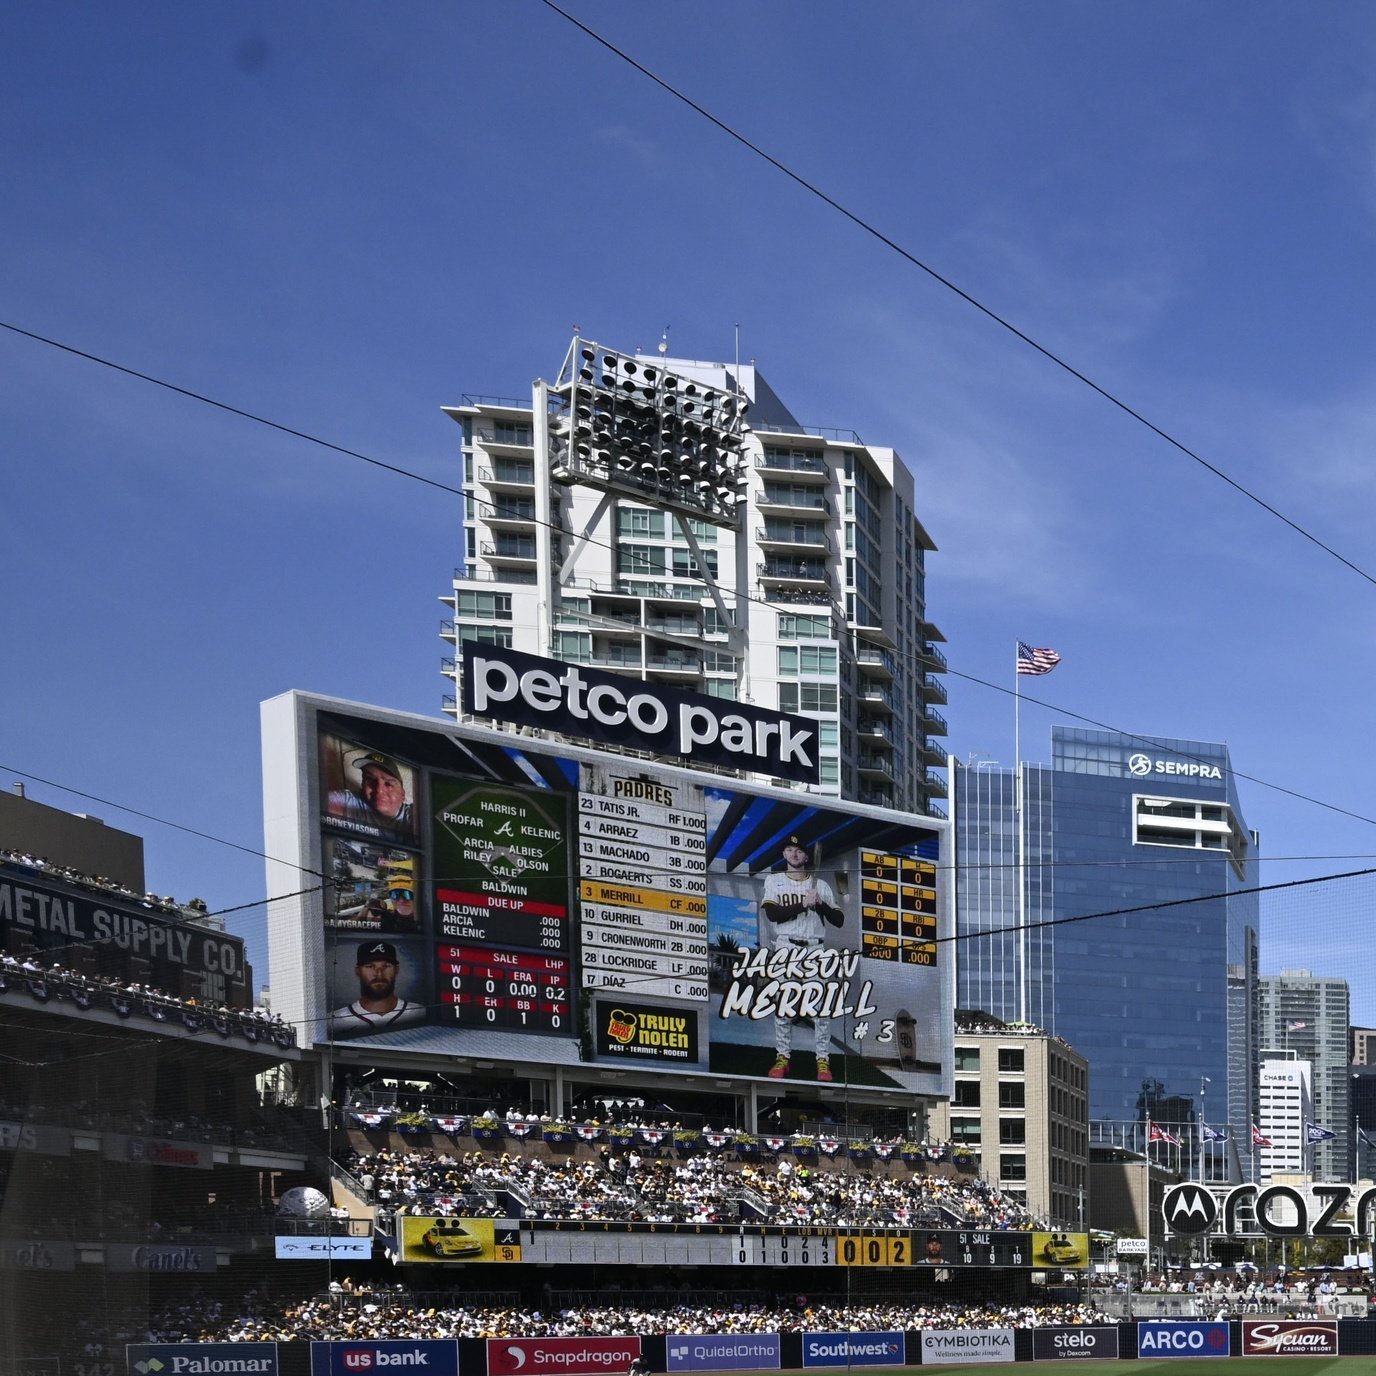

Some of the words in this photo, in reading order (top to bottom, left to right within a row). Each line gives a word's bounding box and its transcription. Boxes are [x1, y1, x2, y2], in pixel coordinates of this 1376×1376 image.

[473, 656, 668, 734] petco
[680, 703, 814, 767] park
[1155, 760, 1222, 779] SEMPRA
[614, 781, 673, 806] PADRES
[481, 801, 517, 816] HARRIS
[519, 808, 526, 818] II
[581, 798, 593, 809] 23
[598, 801, 625, 815] TATIS
[626, 806, 640, 817] JR.
[682, 816, 706, 829] 1.000
[443, 812, 484, 828] PROFAR
[521, 825, 561, 840] KELENIC
[599, 823, 638, 839] ARRAEZ
[464, 838, 494, 850] ARCIA
[509, 844, 543, 858] ALBIES
[464, 850, 492, 863] RILEY
[583, 843, 593, 853] 13
[600, 845, 650, 862] MACHADO
[492, 865, 517, 878] SALE
[517, 858, 549, 872] OLSON
[600, 867, 653, 884] BOGAERTS
[482, 881, 527, 896] BALDWIN
[601, 889, 643, 904] MERRILL
[442, 903, 490, 918] BALDWIN
[488, 897, 508, 909] DUE
[510, 900, 524, 910] UP
[443, 915, 473, 926] ARCIA
[584, 909, 595, 918] 10
[601, 911, 643, 926] GURRIEL
[443, 925, 485, 939] KELENIC
[93, 909, 192, 966] SUPPLY
[203, 939, 242, 978] CO.
[602, 932, 666, 950] CRONENWORTH
[450, 948, 460, 957] 51
[493, 952, 519, 965] SALE
[545, 959, 563, 969] LHP
[584, 953, 597, 963] 28
[602, 954, 657, 970] LOCKRIDGE
[732, 947, 860, 978] JACKSON
[514, 971, 532, 982] ERA
[587, 975, 595, 985] 17
[603, 975, 626, 988] DÍAZ
[509, 983, 537, 997] 0.00
[545, 987, 565, 1000] 0.2
[721, 980, 877, 1019] MERRILL
[639, 1013, 686, 1032] TRULY
[853, 1021, 869, 1039] #
[876, 1020, 895, 1042] 3
[608, 1044, 624, 1052] PEST
[630, 1046, 658, 1055] TERMITE
[663, 1050, 688, 1058] RODENT
[959, 1233, 967, 1244] 51
[972, 1233, 990, 1245] SALE
[1121, 1240, 1146, 1249] petco
[308, 1244, 364, 1252] ELYTE
[925, 1335, 1011, 1348] CYMBIOTIKA
[1054, 1330, 1096, 1348] stelo
[1141, 1330, 1204, 1349] ARCO
[1250, 1324, 1329, 1353] Sycuan
[346, 1352, 371, 1367] us
[376, 1349, 428, 1367] bank
[534, 1349, 632, 1366] Snapdragon
[694, 1345, 775, 1358] QuidelOrtho
[809, 1342, 888, 1358] Southwest
[171, 1356, 273, 1374] Palomar
